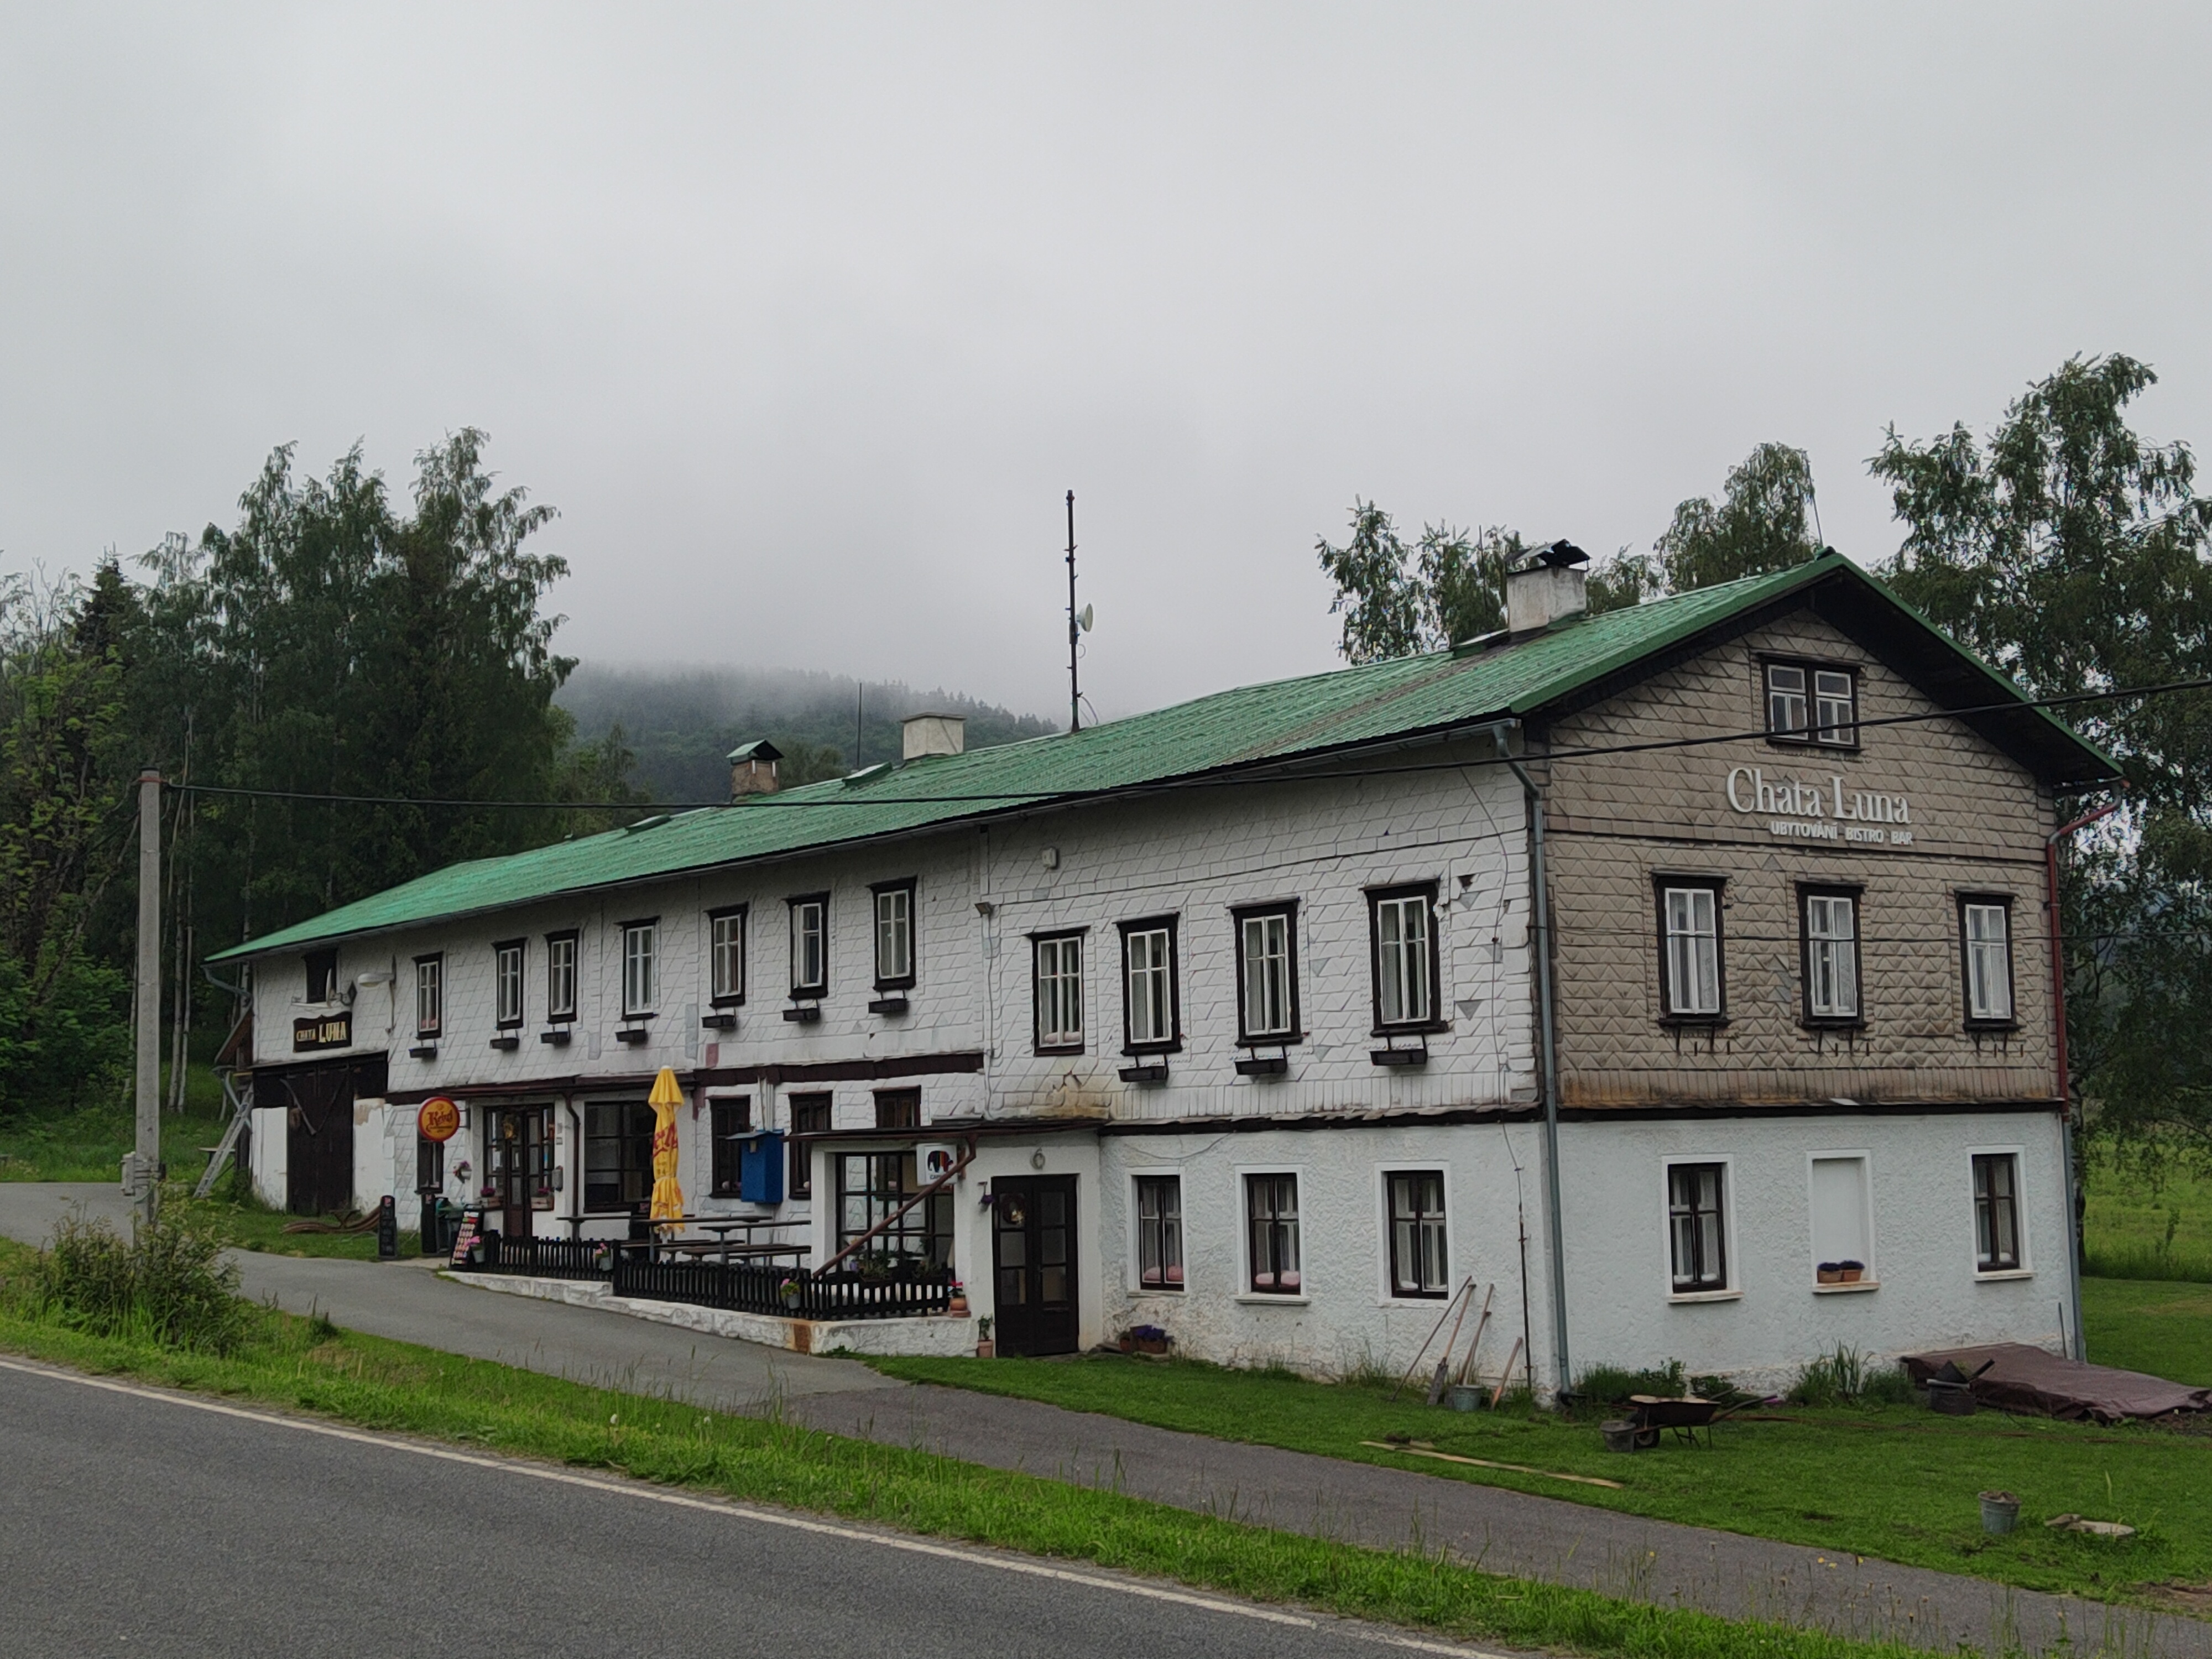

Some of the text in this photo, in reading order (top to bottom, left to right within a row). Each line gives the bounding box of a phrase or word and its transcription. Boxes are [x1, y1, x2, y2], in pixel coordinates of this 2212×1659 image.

[1726, 767, 1912, 825] Chata Luna
[1770, 820, 1914, 846] UBYTOVÁNÍ BISTRO BAR
[296, 1021, 347, 1043] CHATA LUNA
